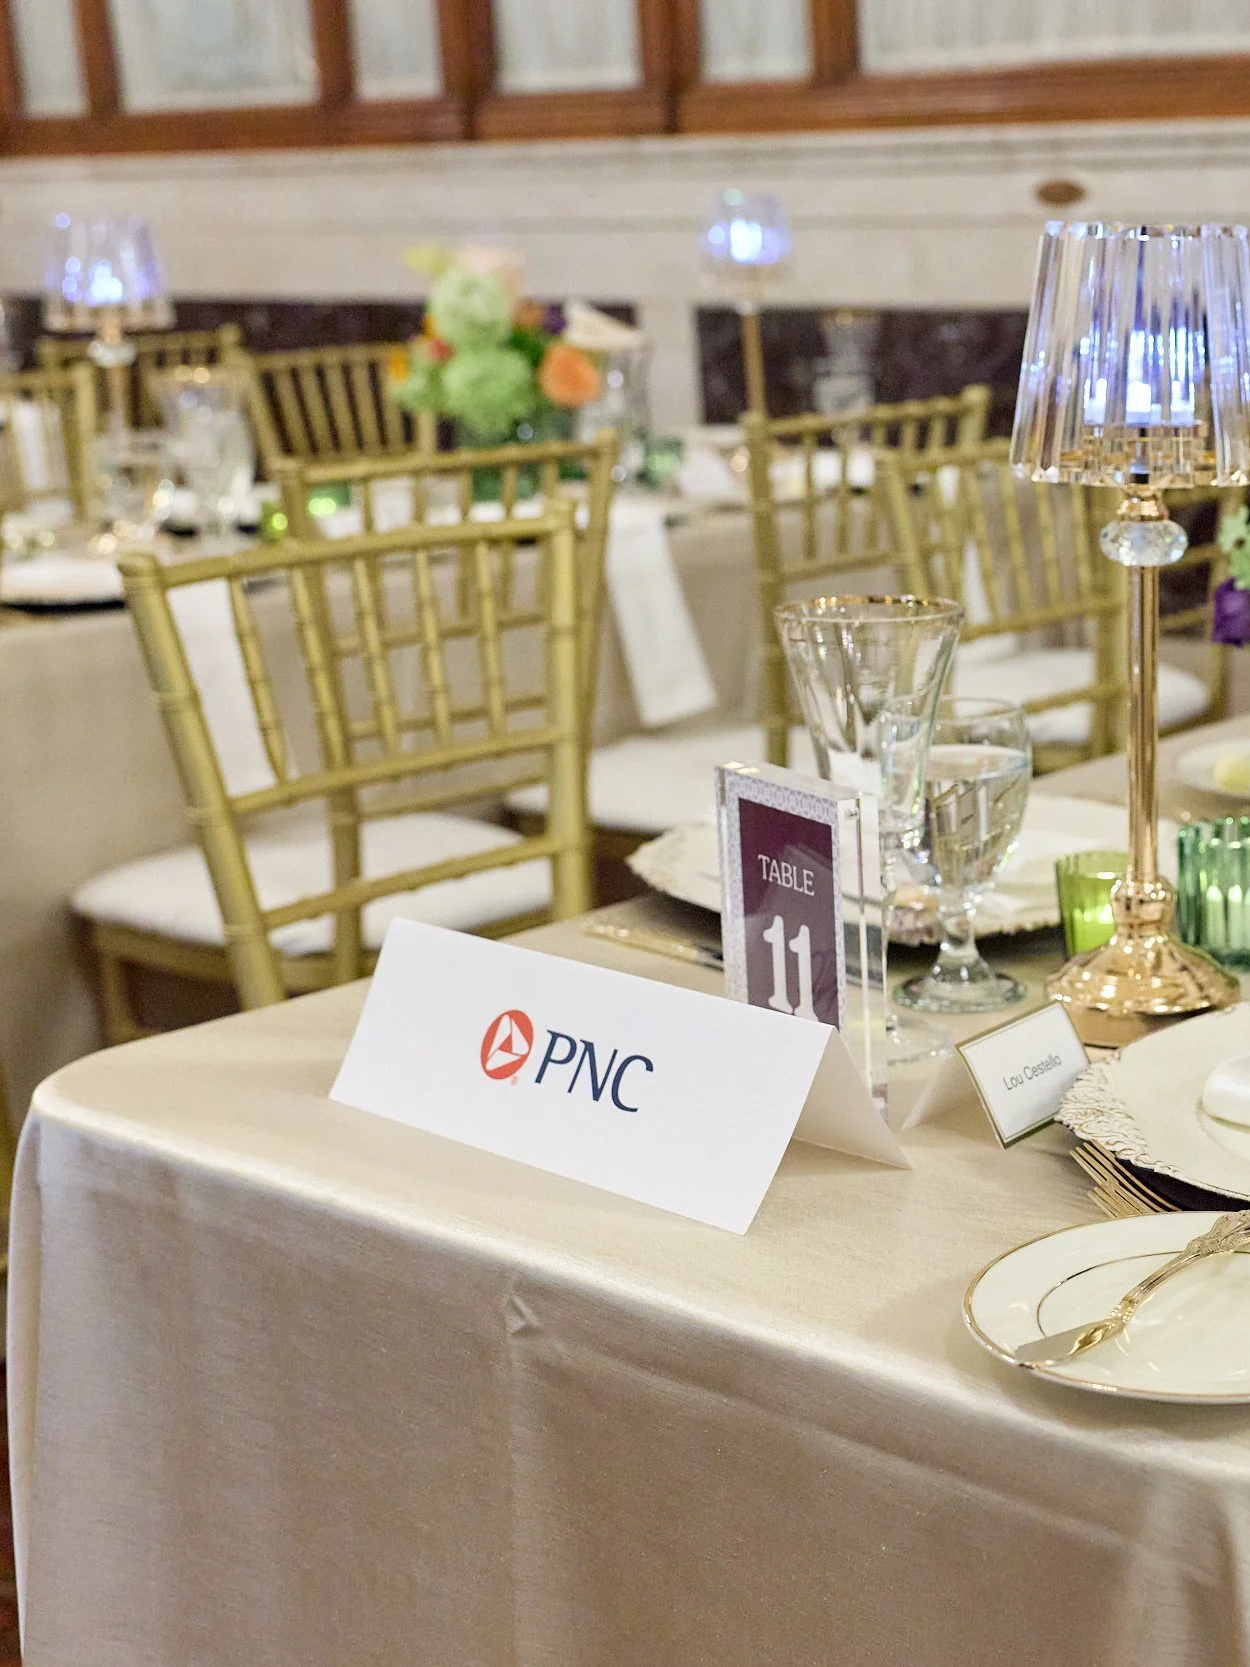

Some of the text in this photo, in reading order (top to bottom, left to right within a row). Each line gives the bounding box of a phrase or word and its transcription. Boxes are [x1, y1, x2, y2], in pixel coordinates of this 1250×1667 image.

[757, 854, 815, 896] TABLE
[762, 915, 819, 1022] 11
[534, 1029, 654, 1113] PNC
[1002, 1073, 1024, 1091] Lou
